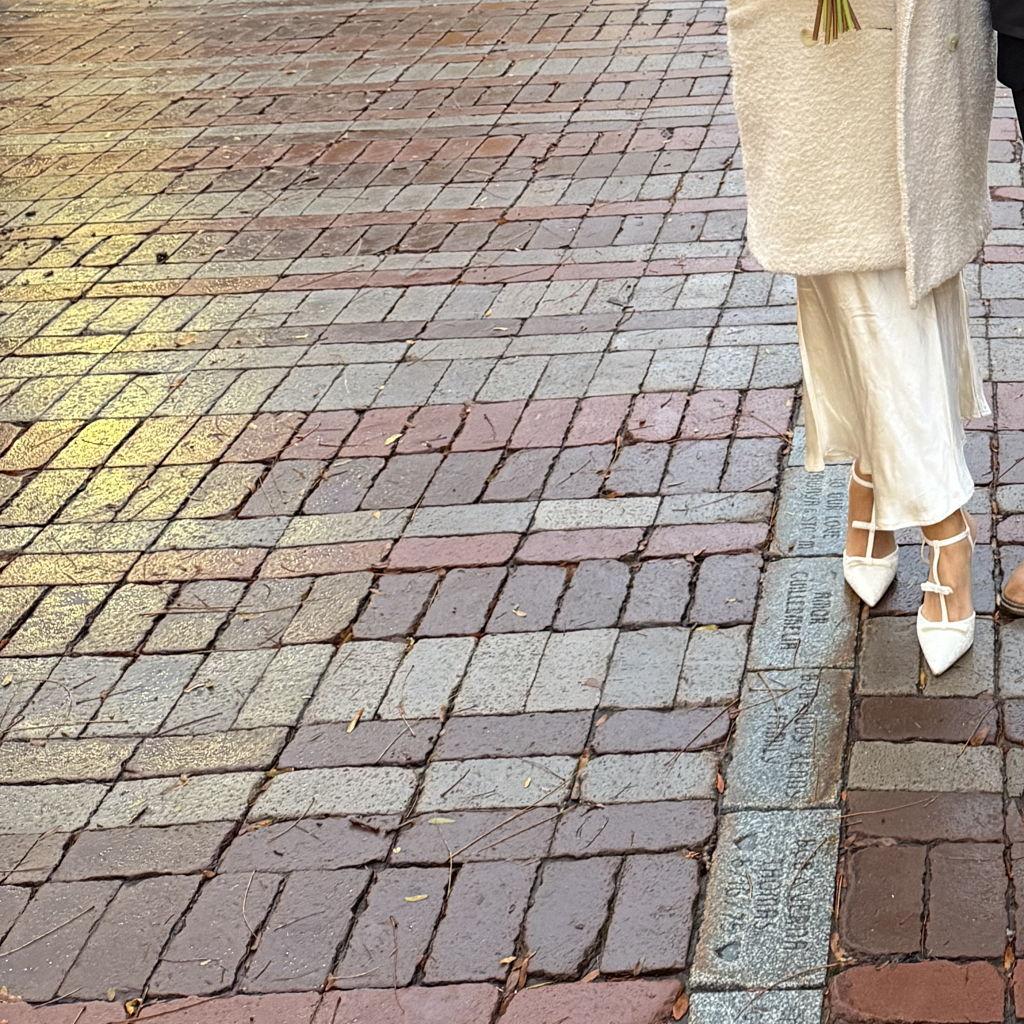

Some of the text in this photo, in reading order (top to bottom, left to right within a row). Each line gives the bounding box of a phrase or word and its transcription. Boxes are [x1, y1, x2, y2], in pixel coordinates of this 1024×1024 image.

[826, 492, 844, 511] OUR
[822, 516, 842, 539] LOVE
[810, 592, 833, 625] AMOR
